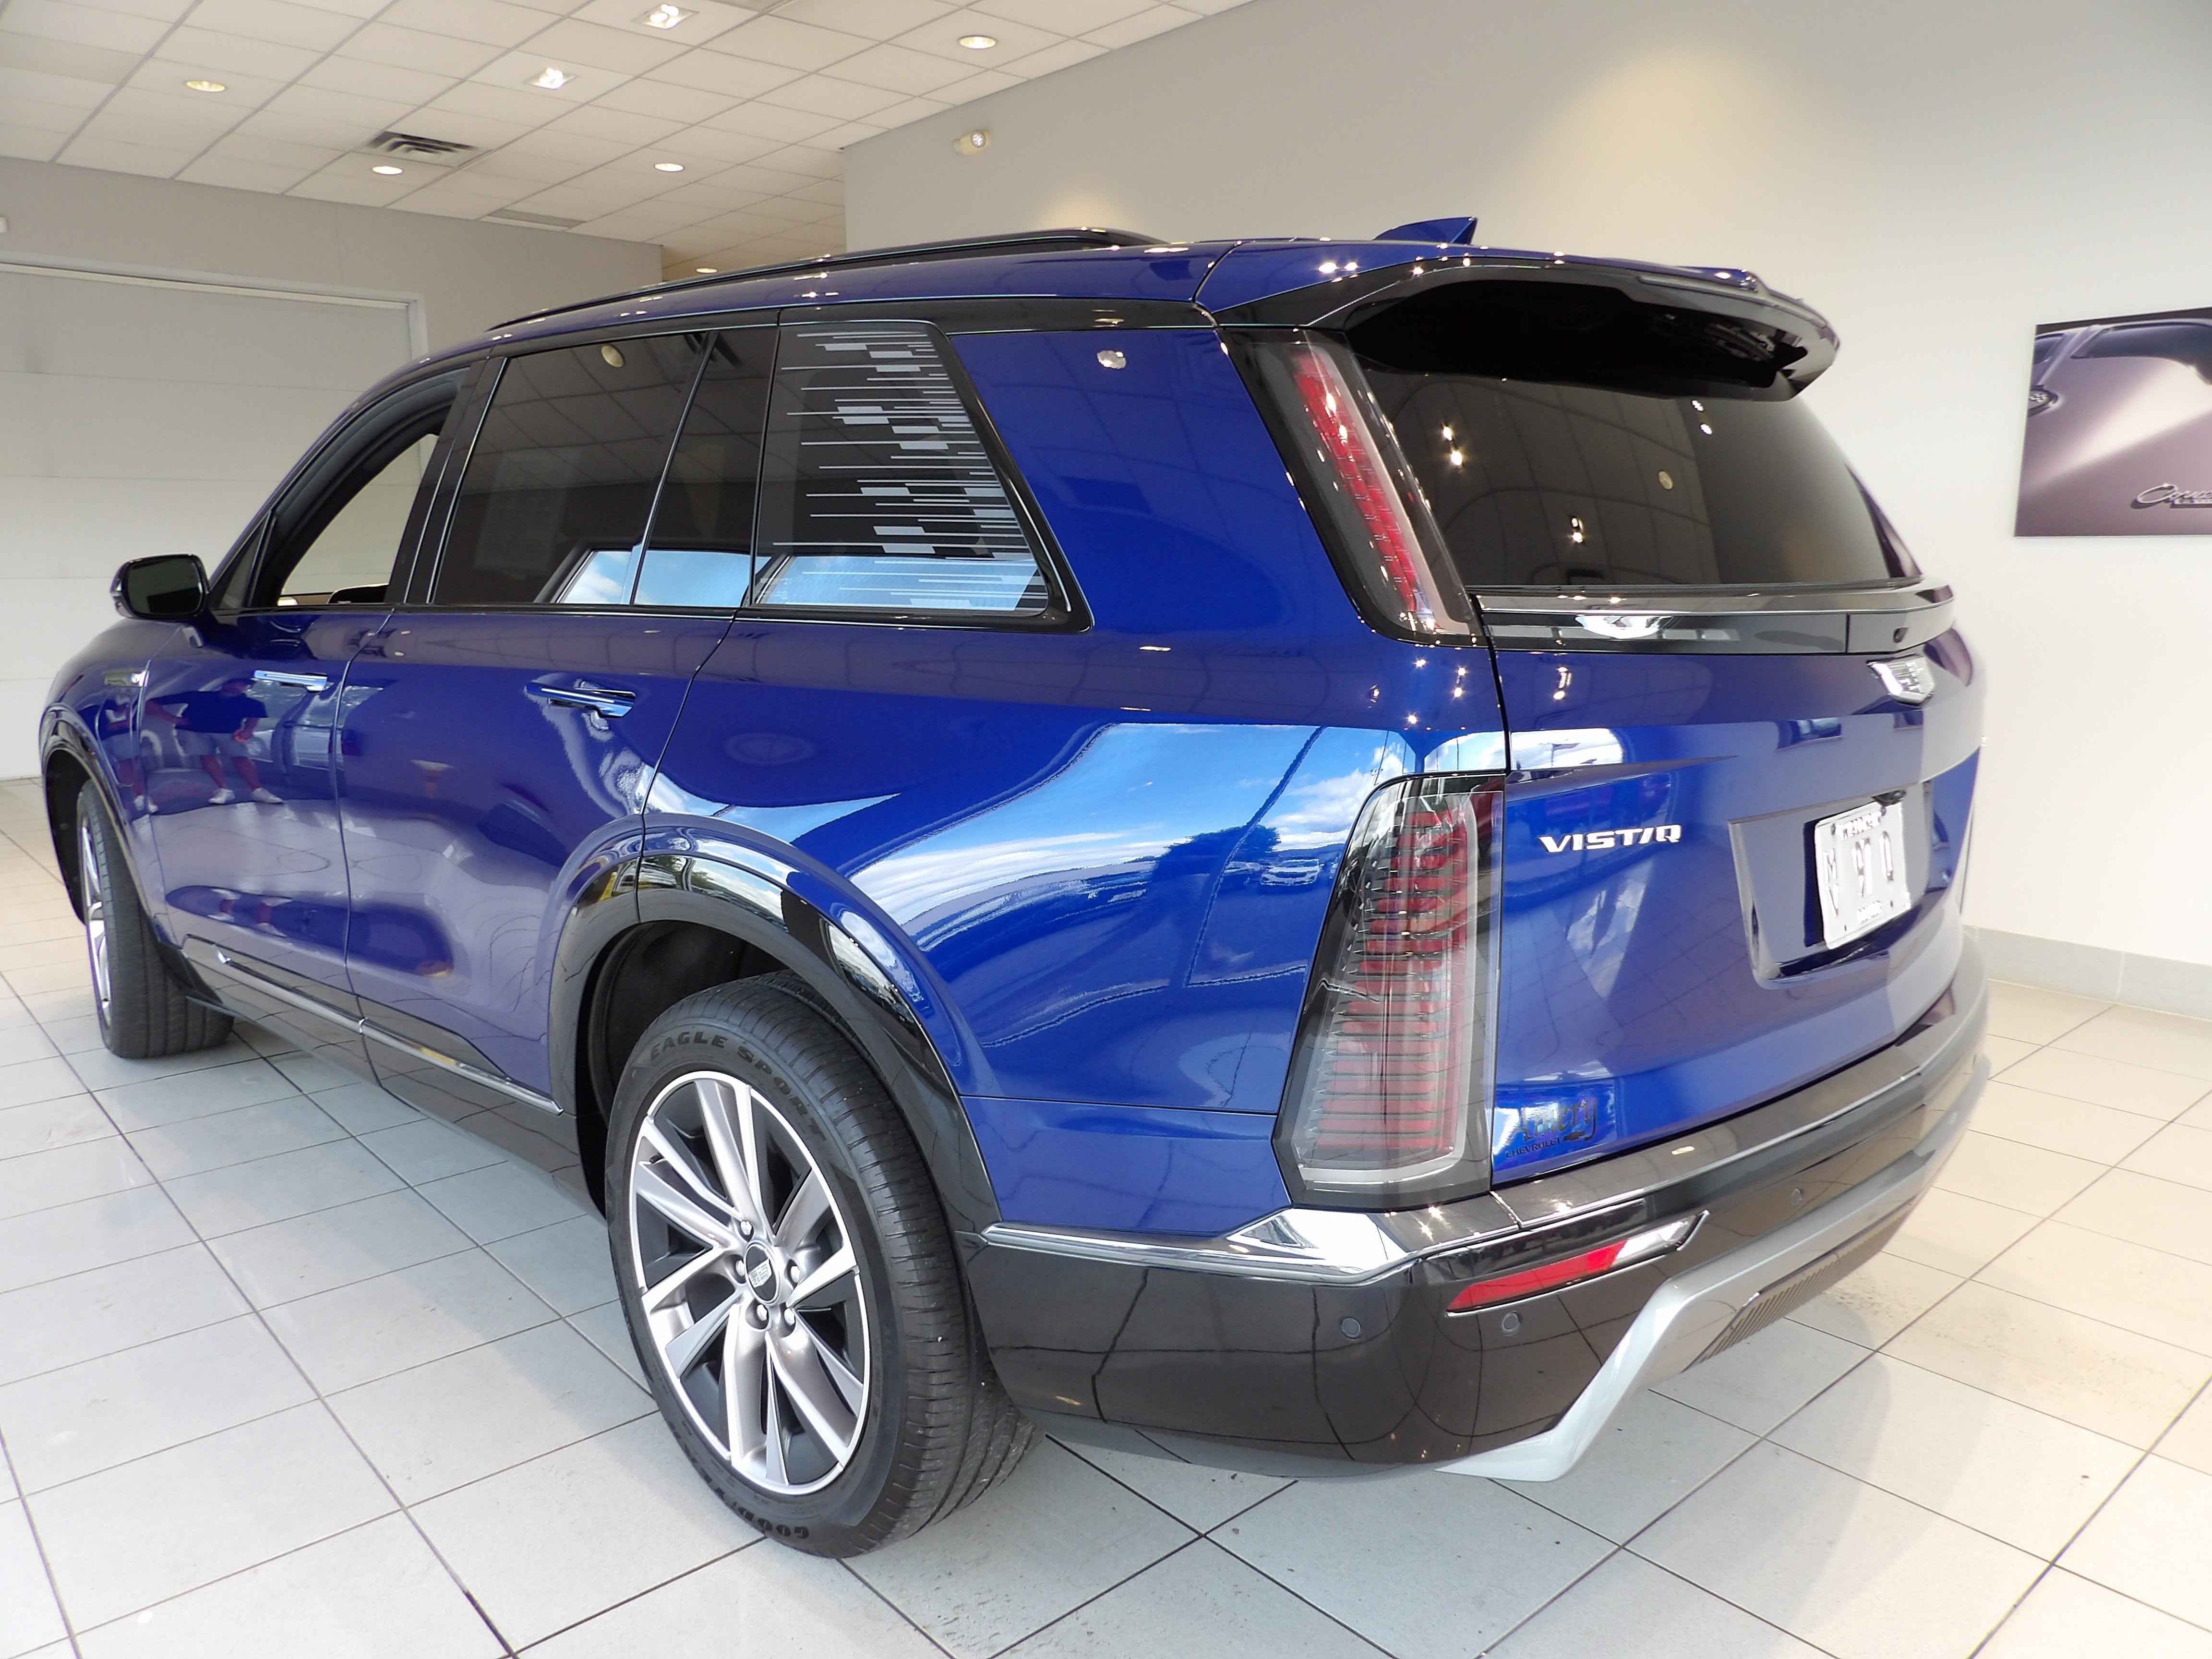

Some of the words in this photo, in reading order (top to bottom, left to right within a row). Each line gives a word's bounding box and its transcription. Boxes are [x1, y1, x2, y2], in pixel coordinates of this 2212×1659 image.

[1538, 824, 1682, 853] VISTIQ
[650, 1031, 729, 1060] EAGLE
[737, 1045, 826, 1142] SPORT
[1505, 1137, 1561, 1158] CHEVROLET
